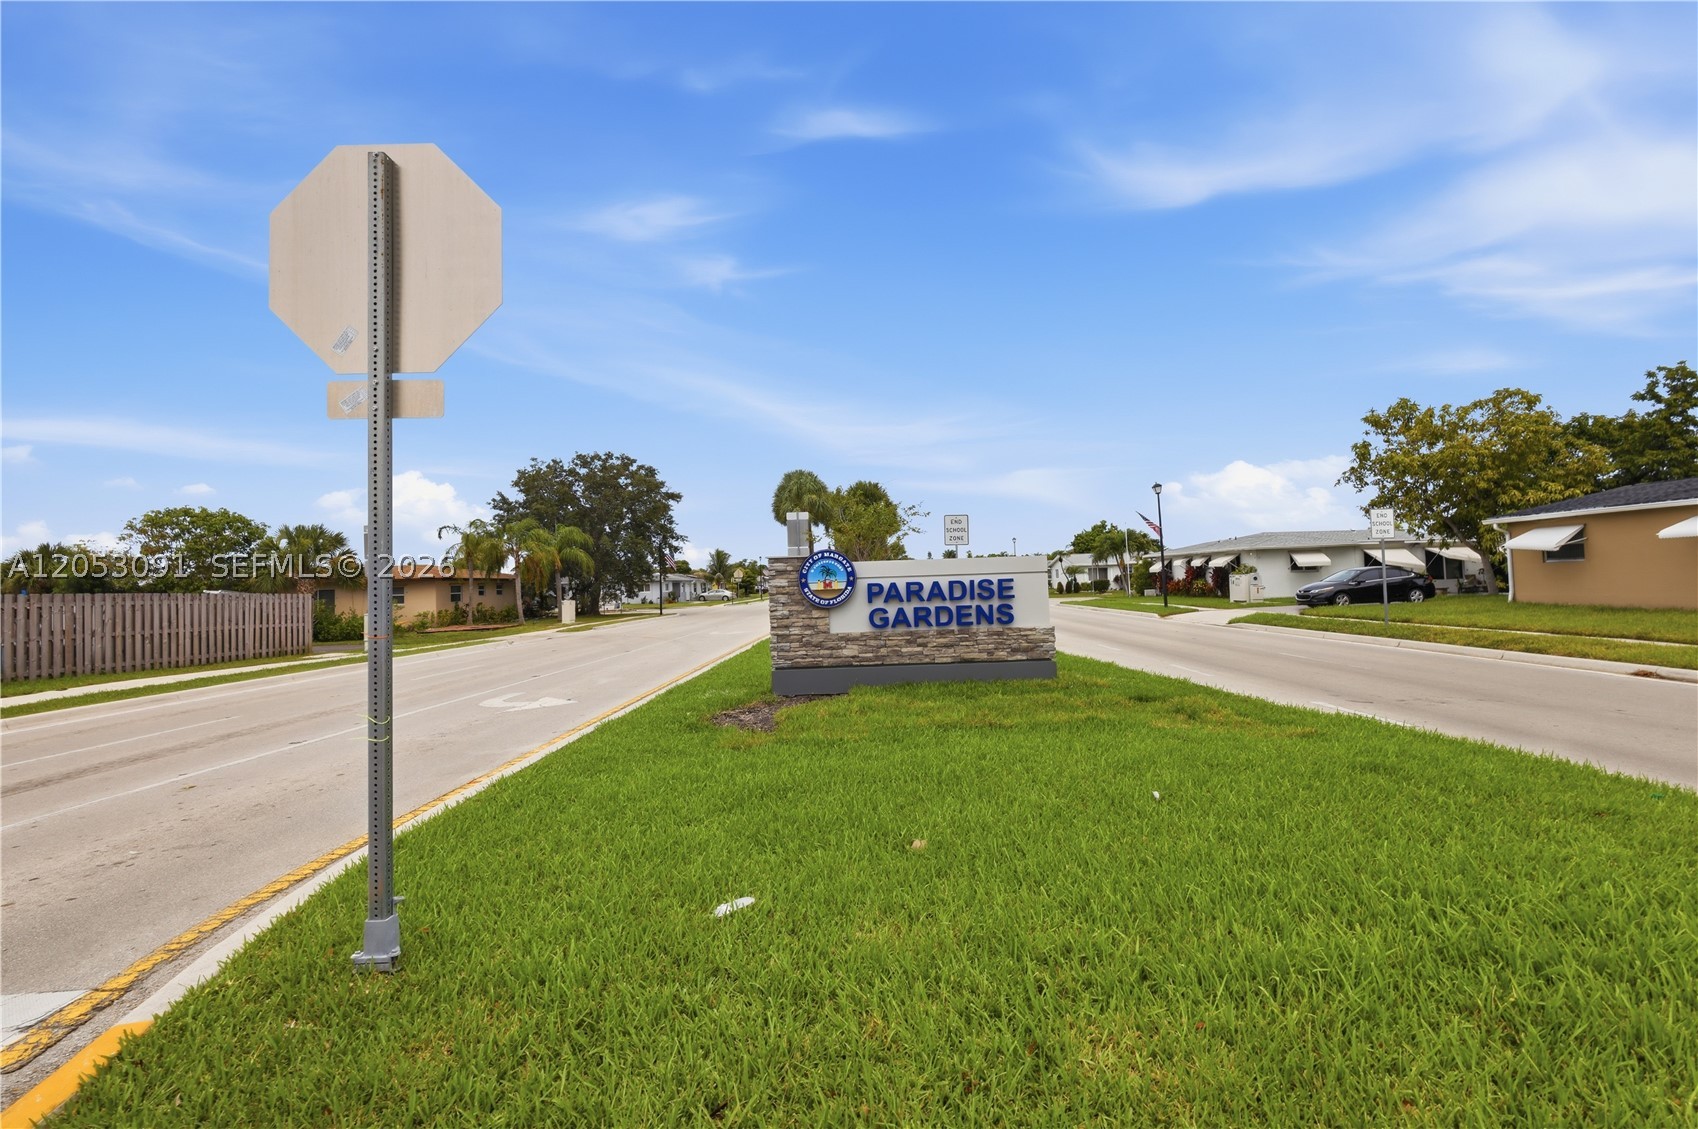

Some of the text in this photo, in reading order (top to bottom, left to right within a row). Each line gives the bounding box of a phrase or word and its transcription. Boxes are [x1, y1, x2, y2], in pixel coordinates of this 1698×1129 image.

[802, 558, 813, 573] CITY
[824, 552, 852, 572] MARGATE
[803, 587, 820, 604] STATE
[829, 586, 852, 604] FLORIDA
[867, 578, 1015, 603] PARADISE
[868, 603, 1015, 629] GARDENS
